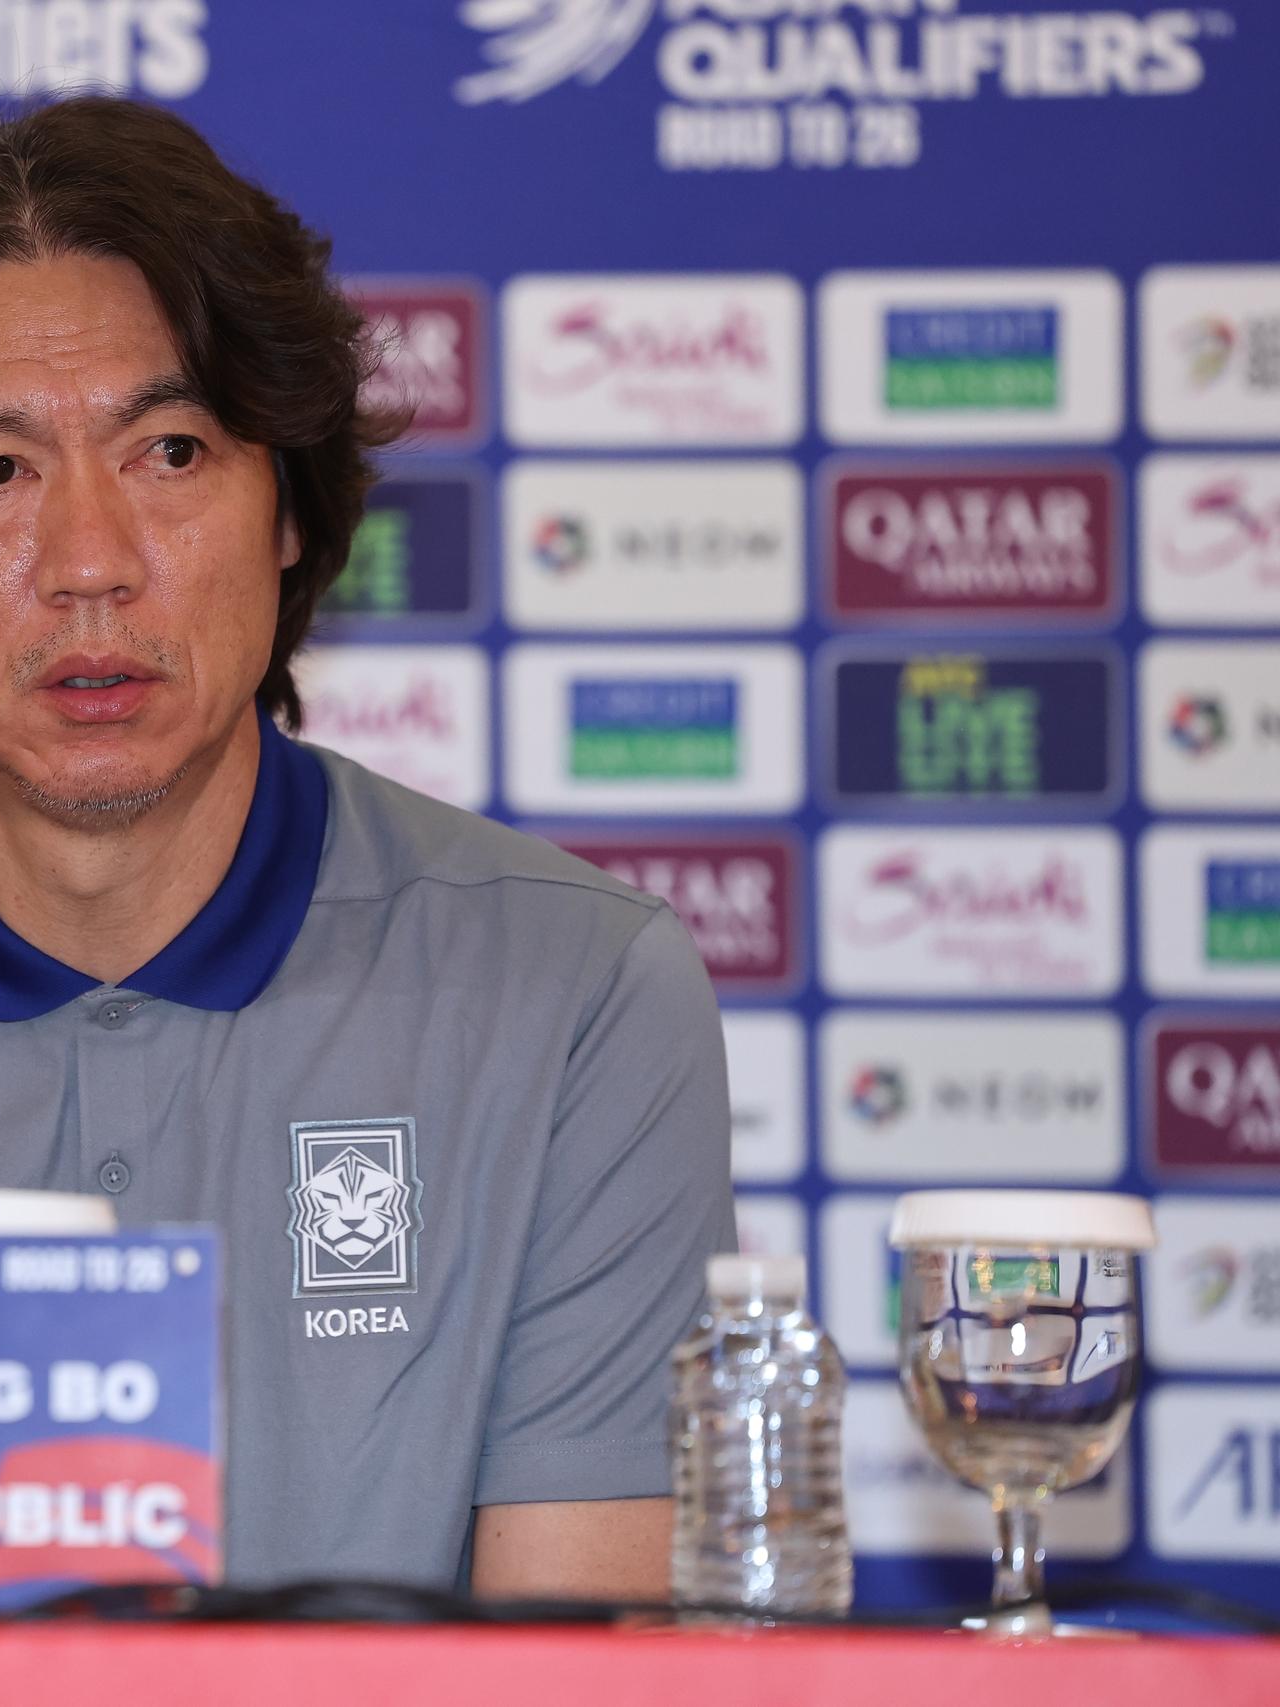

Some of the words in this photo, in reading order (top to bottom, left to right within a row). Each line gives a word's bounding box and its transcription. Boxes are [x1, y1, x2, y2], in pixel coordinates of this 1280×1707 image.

[660, 16, 1202, 104] QUALIFIERS
[844, 490, 1092, 566] QATAR
[305, 1306, 410, 1338] KOREA
[48, 1360, 159, 1423] BO
